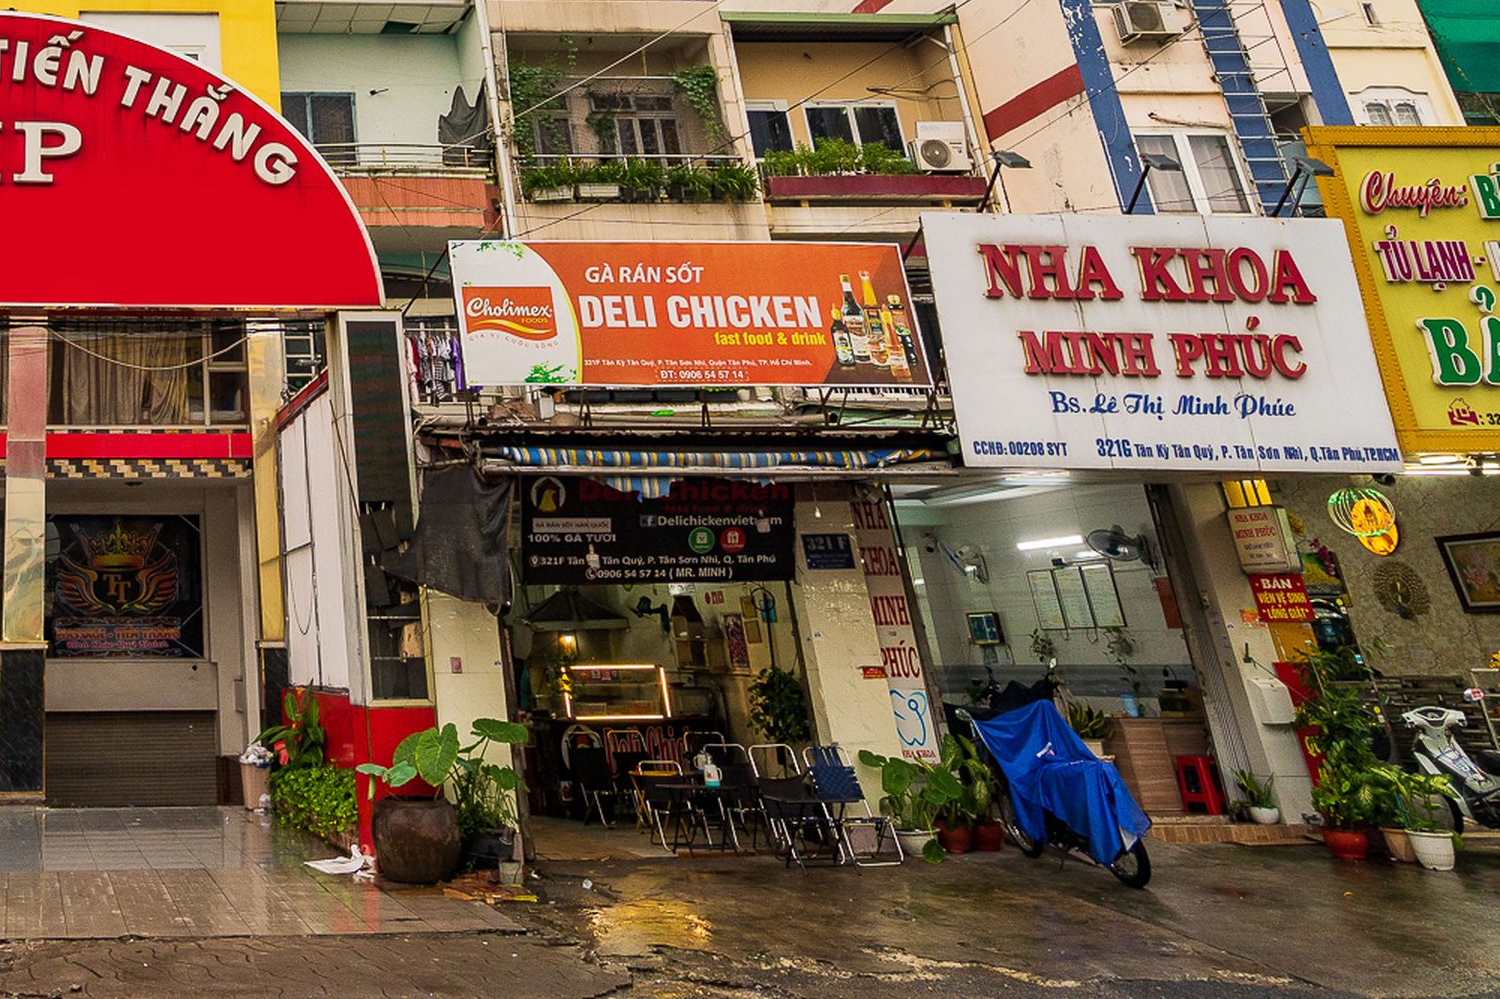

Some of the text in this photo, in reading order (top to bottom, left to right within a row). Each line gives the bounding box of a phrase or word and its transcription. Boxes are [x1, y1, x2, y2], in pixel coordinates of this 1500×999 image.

[120, 65, 299, 186] THẮNG
[1373, 225, 1413, 282] TỦ
[1410, 240, 1476, 291] LẠNH
[585, 261, 704, 283] GÀ RÁN SỐT
[977, 242, 1317, 304] NHA KHOA
[466, 296, 553, 318] Cholimex
[578, 295, 823, 328] DELI CHICKEN
[714, 331, 826, 346] fast food & drink
[1016, 316, 1307, 380] MINH PHÚC
[660, 370, 744, 379] ĐT: 0906 54 57 14
[1049, 391, 1297, 420] Bs. Lê Thị Minh Phúc
[1008, 441, 1044, 456] 00208
[1047, 442, 1068, 456] SYT
[1095, 438, 1132, 458] 321G
[1134, 444, 1153, 458] Tân
[1171, 444, 1191, 458] Tân
[1221, 445, 1232, 459] P.
[1233, 445, 1254, 459] Tân
[1258, 445, 1280, 459] Sơn
[658, 515, 782, 526] Delichickenvietm
[528, 534, 560, 542] 100%
[806, 536, 833, 551] 321
[541, 556, 564, 565] 321F
[567, 556, 585, 565] Tân
[602, 556, 619, 565] Tân
[648, 556, 656, 564] P.
[659, 555, 676, 564] Tân
[737, 555, 754, 563] Tân
[597, 567, 726, 578] 0906 54 57 14 MR. MINH
